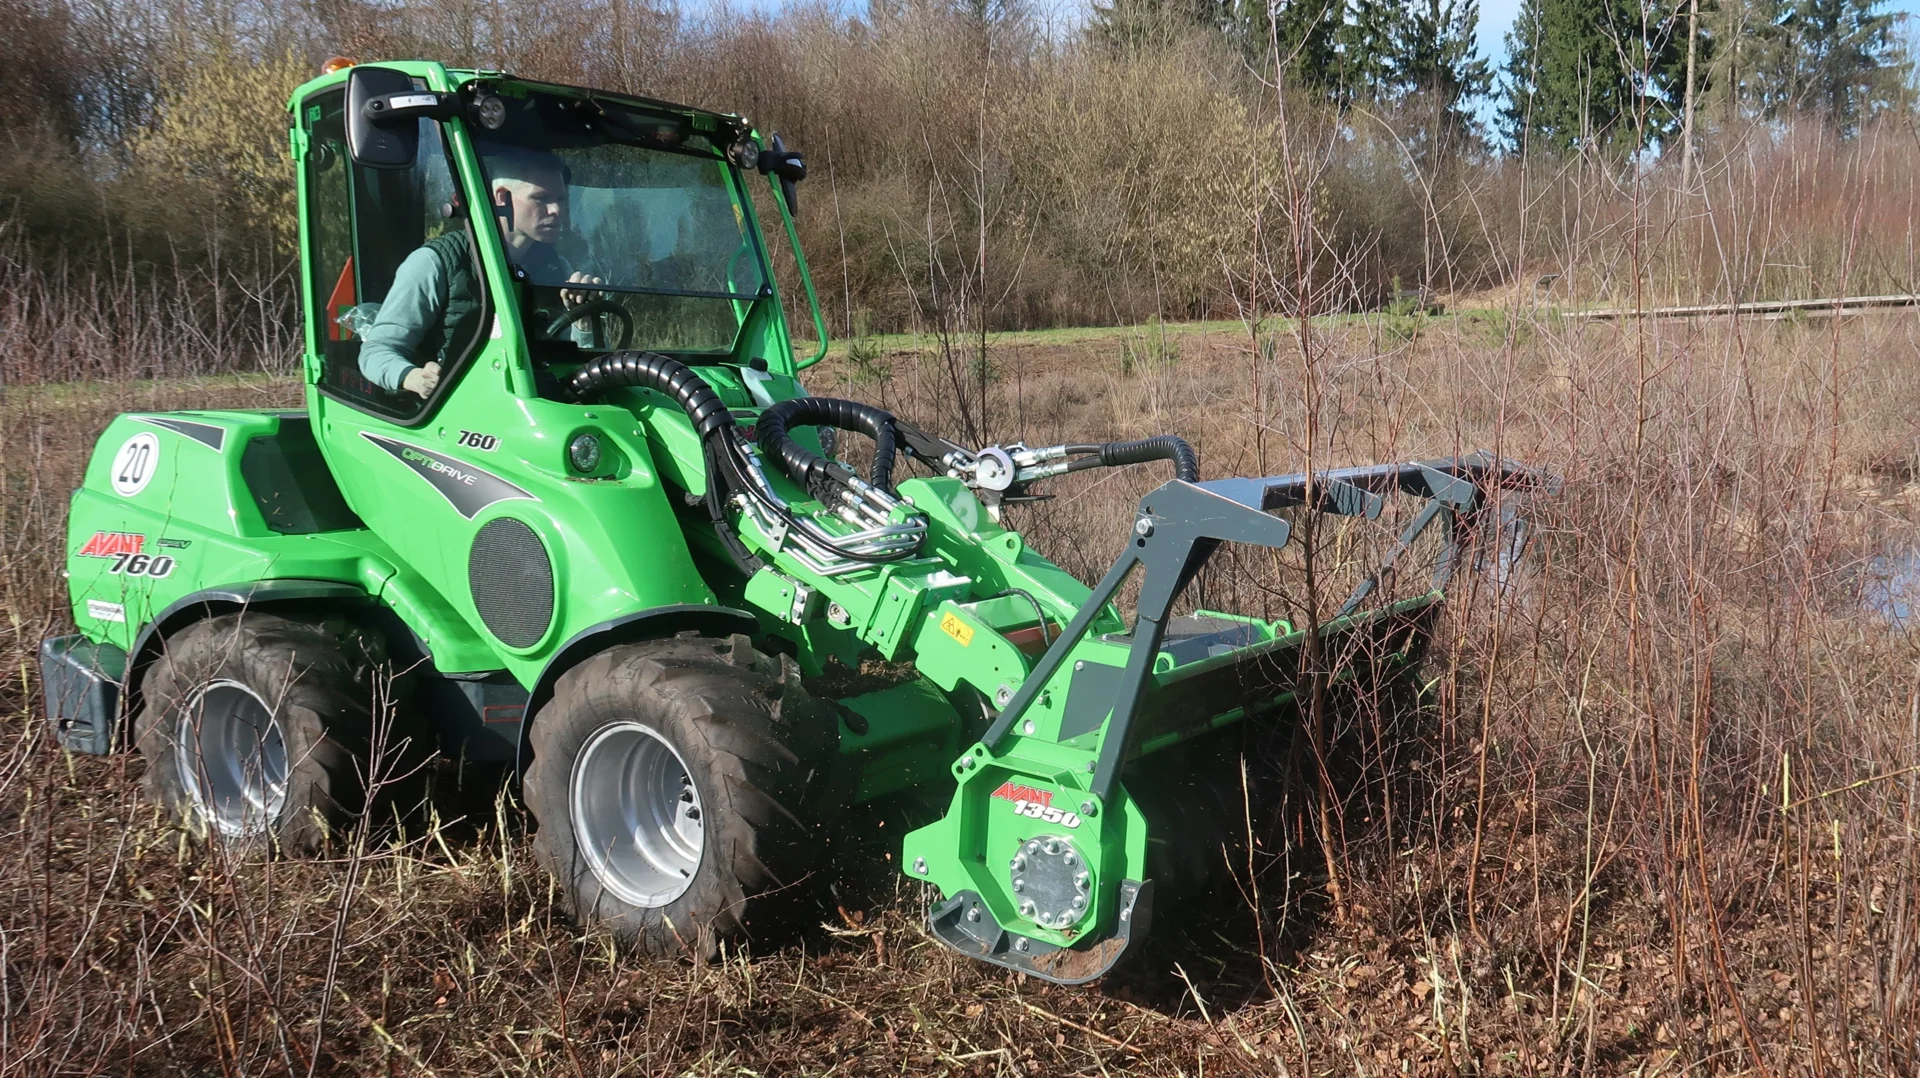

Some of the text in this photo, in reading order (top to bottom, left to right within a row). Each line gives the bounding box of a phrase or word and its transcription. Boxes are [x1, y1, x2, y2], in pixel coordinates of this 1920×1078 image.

[118, 442, 150, 484] 20
[402, 447, 478, 486] OPTIDRIVE
[76, 530, 146, 558] AVANT
[990, 781, 1055, 806] AVANT
[1013, 799, 1081, 829] 1350
